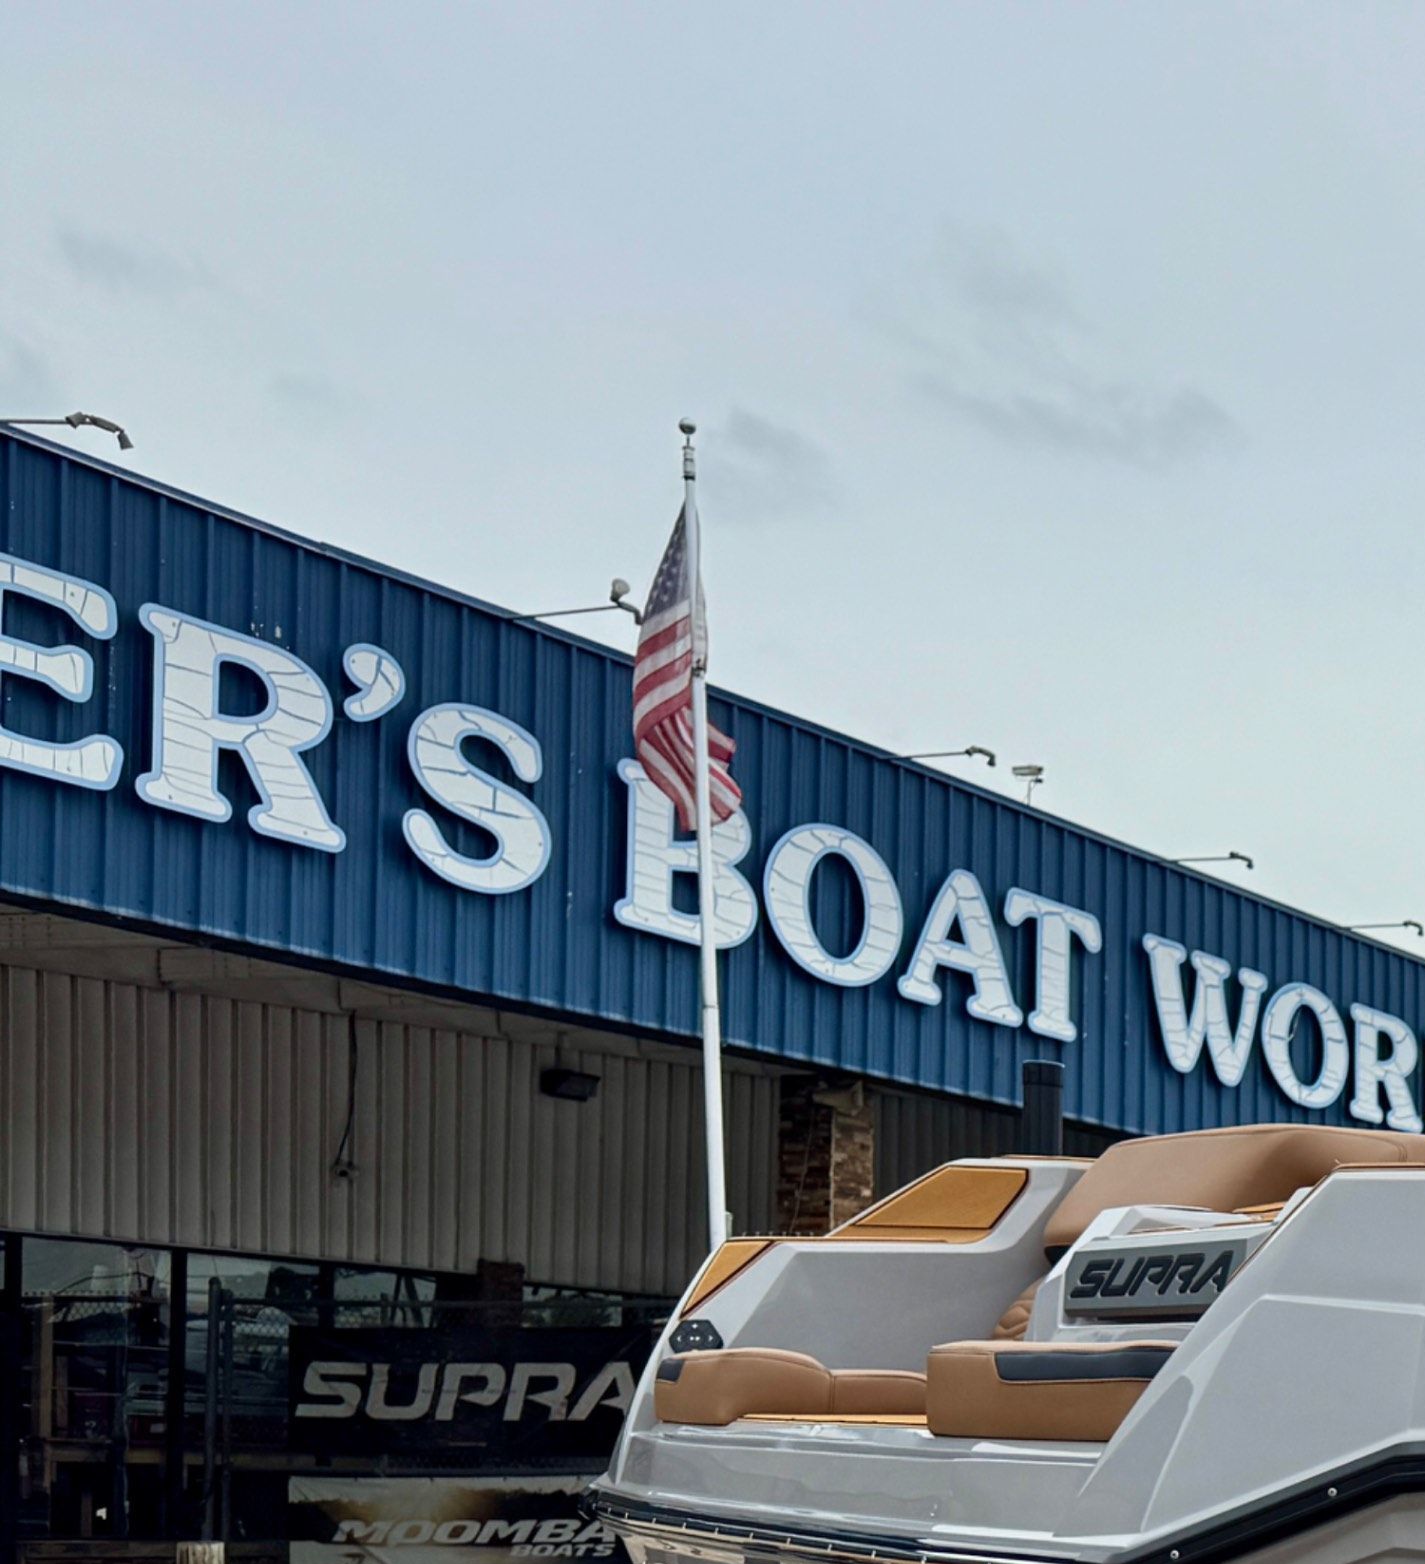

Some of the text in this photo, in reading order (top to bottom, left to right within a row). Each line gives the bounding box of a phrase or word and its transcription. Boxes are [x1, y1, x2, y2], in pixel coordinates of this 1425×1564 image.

[613, 757, 1102, 1042] BOAT
[1069, 1250, 1234, 1299] SUPRA
[295, 1361, 638, 1421] SUPRA
[333, 1519, 616, 1546] MOOMBA
[510, 1544, 616, 1558] BOATS
